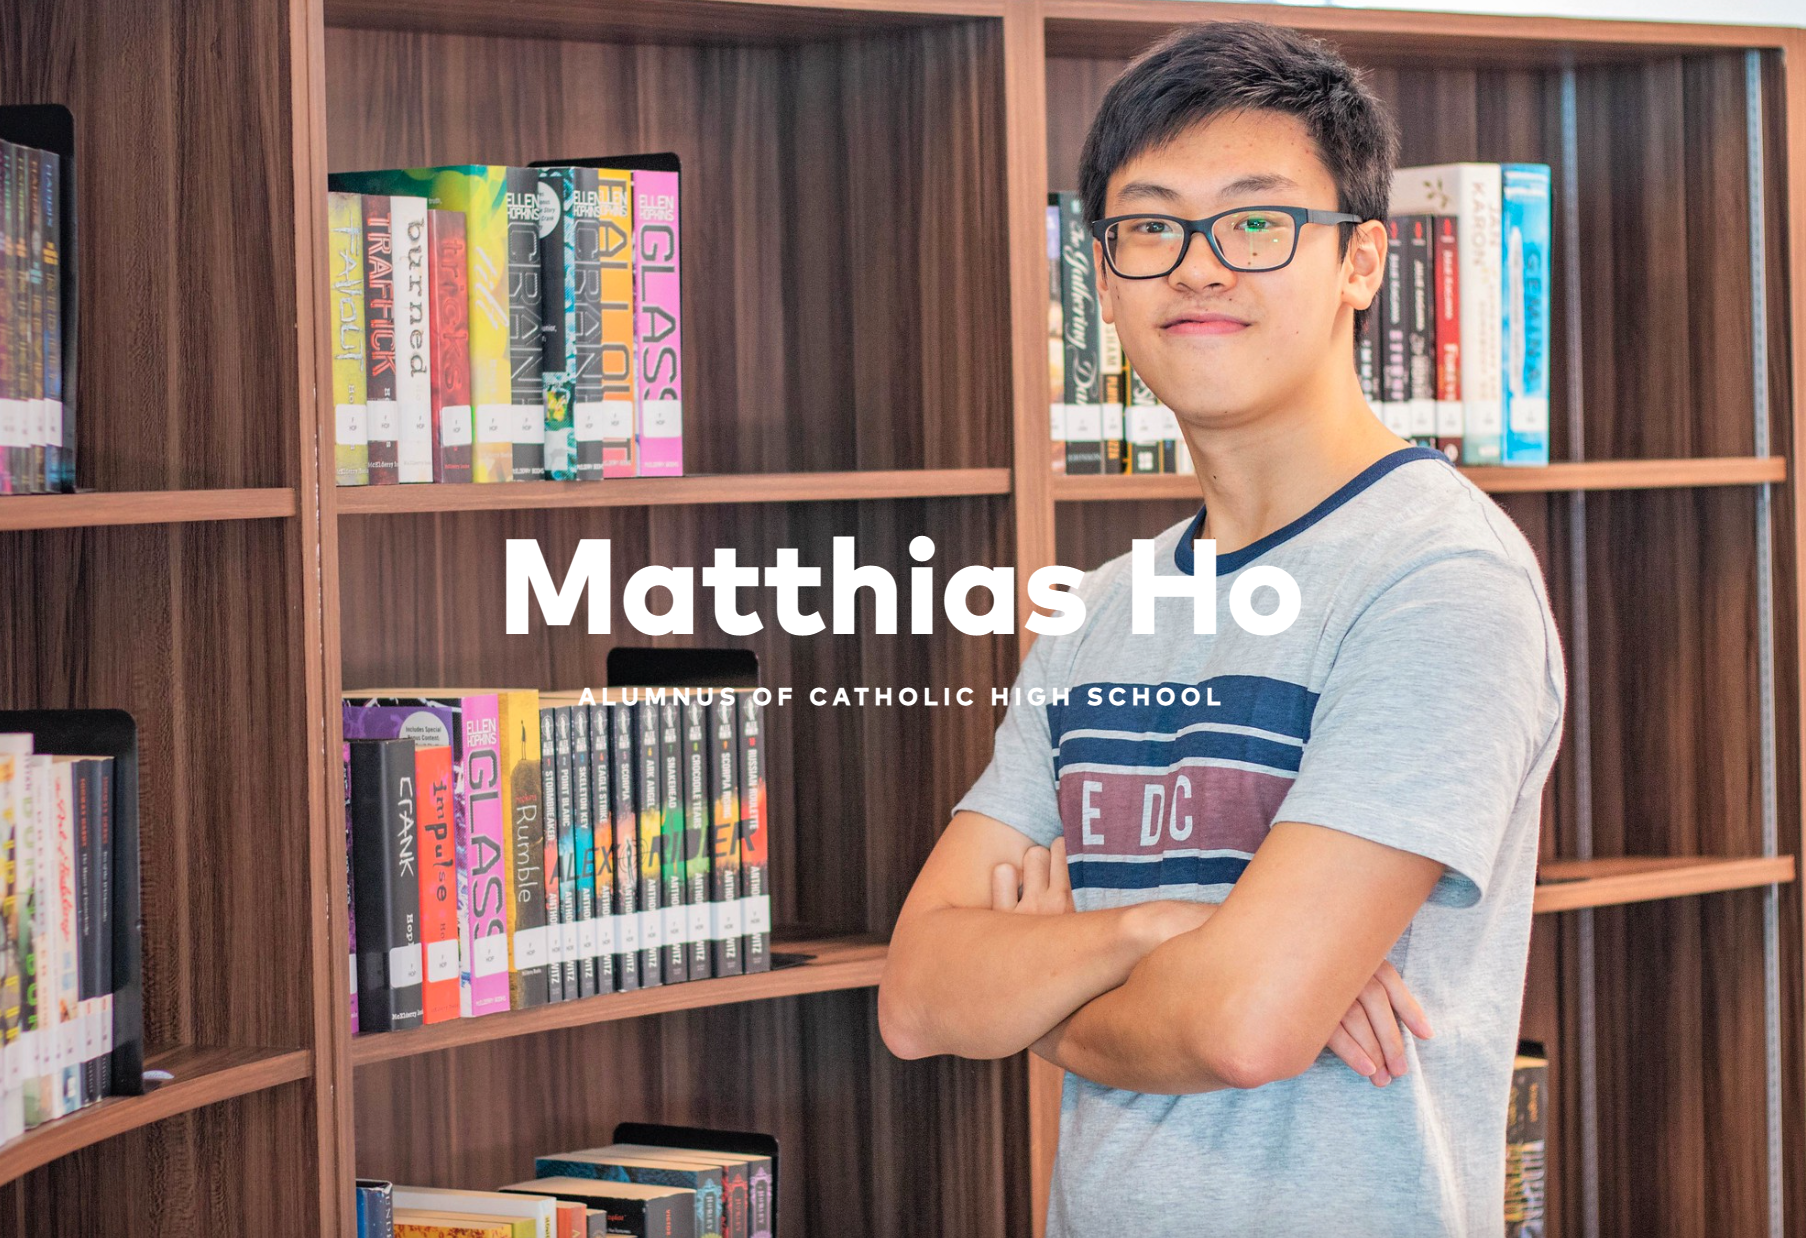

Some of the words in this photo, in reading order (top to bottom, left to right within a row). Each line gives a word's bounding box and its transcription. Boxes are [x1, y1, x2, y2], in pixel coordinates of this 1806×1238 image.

[507, 192, 540, 208] ELLEN
[507, 207, 540, 221] HOPKINS
[573, 203, 600, 218] HOPKINS
[574, 190, 599, 206] ELLEN
[639, 194, 674, 210] ELLEN
[640, 208, 674, 222] HOPKINS
[1472, 182, 1486, 266] KARON
[407, 217, 427, 378] burned
[473, 246, 509, 330] tilt
[1063, 244, 1094, 350] Gathering
[441, 238, 468, 393] tricks
[466, 718, 496, 736] ELLEN
[467, 733, 497, 748] HOPKINS
[561, 769, 570, 795] POINT
[598, 765, 607, 790] EAGLE
[621, 763, 630, 801] SCORPIA
[646, 760, 655, 778] ARK
[667, 757, 677, 808] SNAKEHEAD
[692, 754, 702, 800] CROCODILE
[722, 752, 732, 789] SCORPIA
[748, 749, 758, 786] RUSSIAN
[545, 770, 555, 840] STORMBREAKER
[579, 766, 588, 810] SKELETON
[646, 780, 656, 808] ANGEL
[562, 797, 571, 827] BLANC
[598, 792, 608, 823] STRIKE
[693, 802, 702, 829] TEARS
[1082, 780, 1104, 845] E
[1140, 775, 1193, 846] DC
[516, 805, 540, 902] Rumble
[549, 844, 620, 885] ALEX
[648, 818, 759, 868] RIDER
